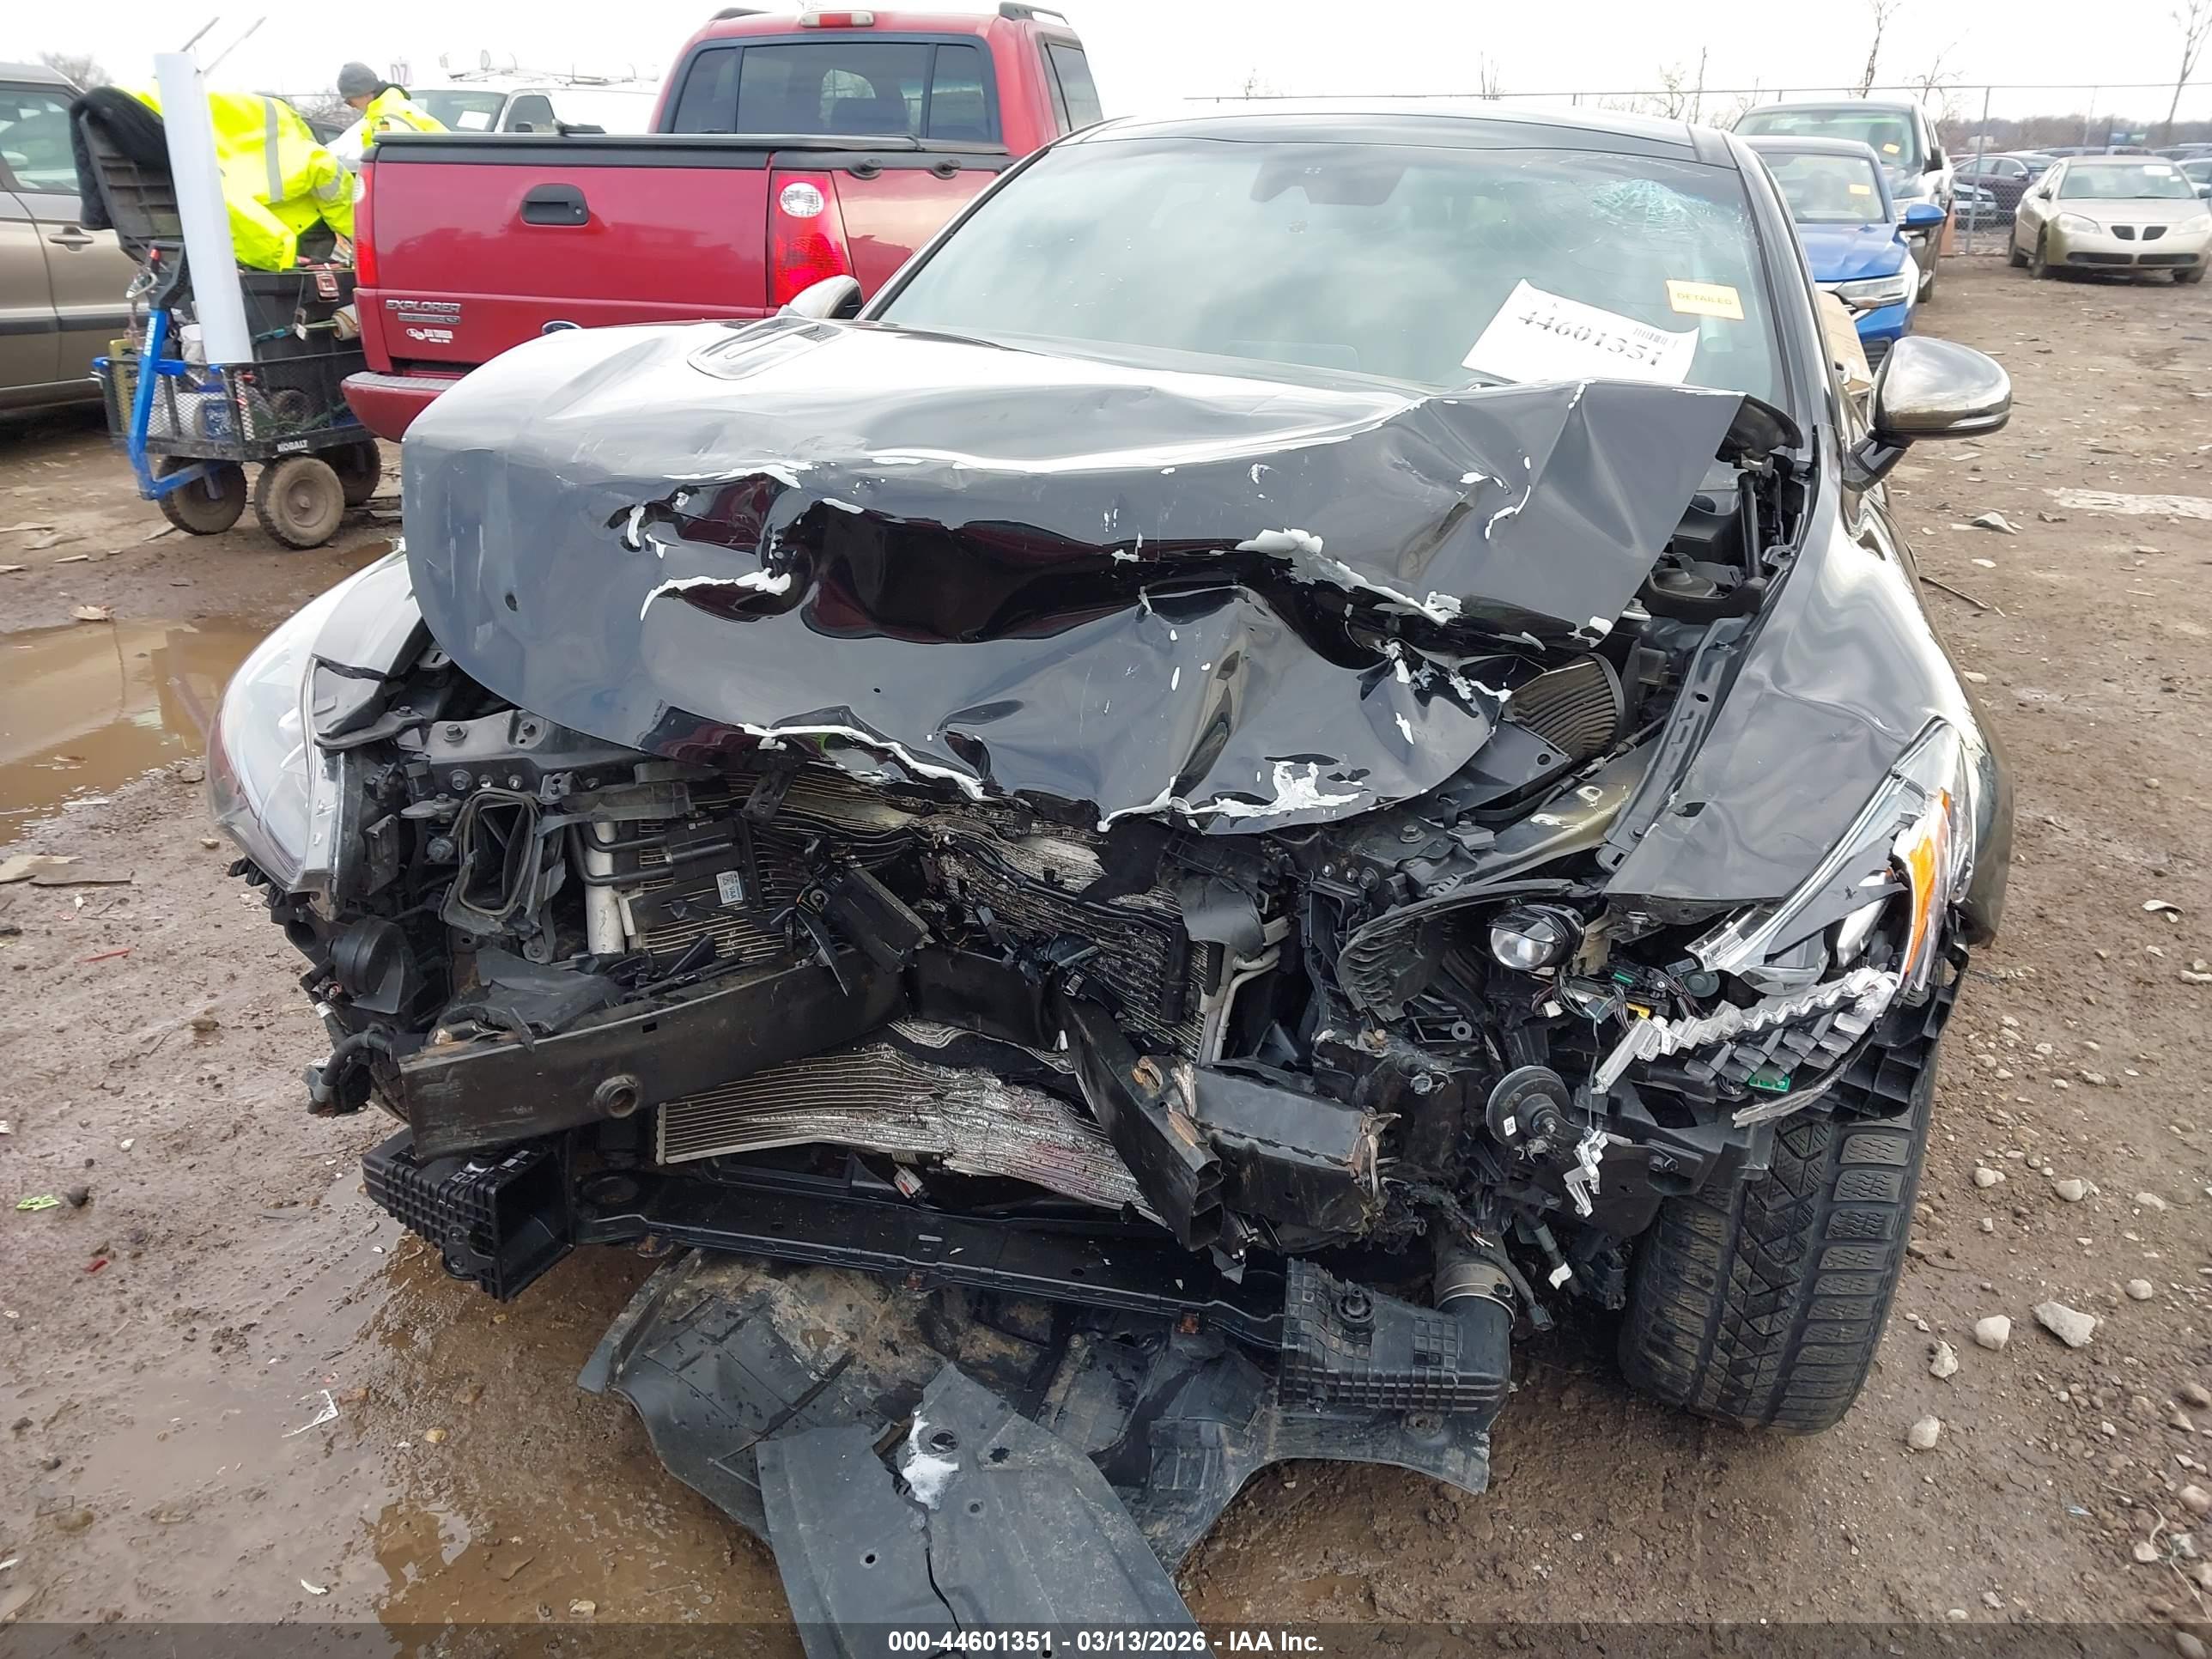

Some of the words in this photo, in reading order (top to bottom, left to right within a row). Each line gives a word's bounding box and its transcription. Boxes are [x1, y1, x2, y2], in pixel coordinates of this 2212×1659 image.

[385, 299, 461, 313] EXPLORER
[1676, 292, 1733, 306] DETAILED
[143, 317, 157, 357] KOBALT
[1517, 311, 1663, 367] 44601351
[276, 439, 308, 453] KOBALT
